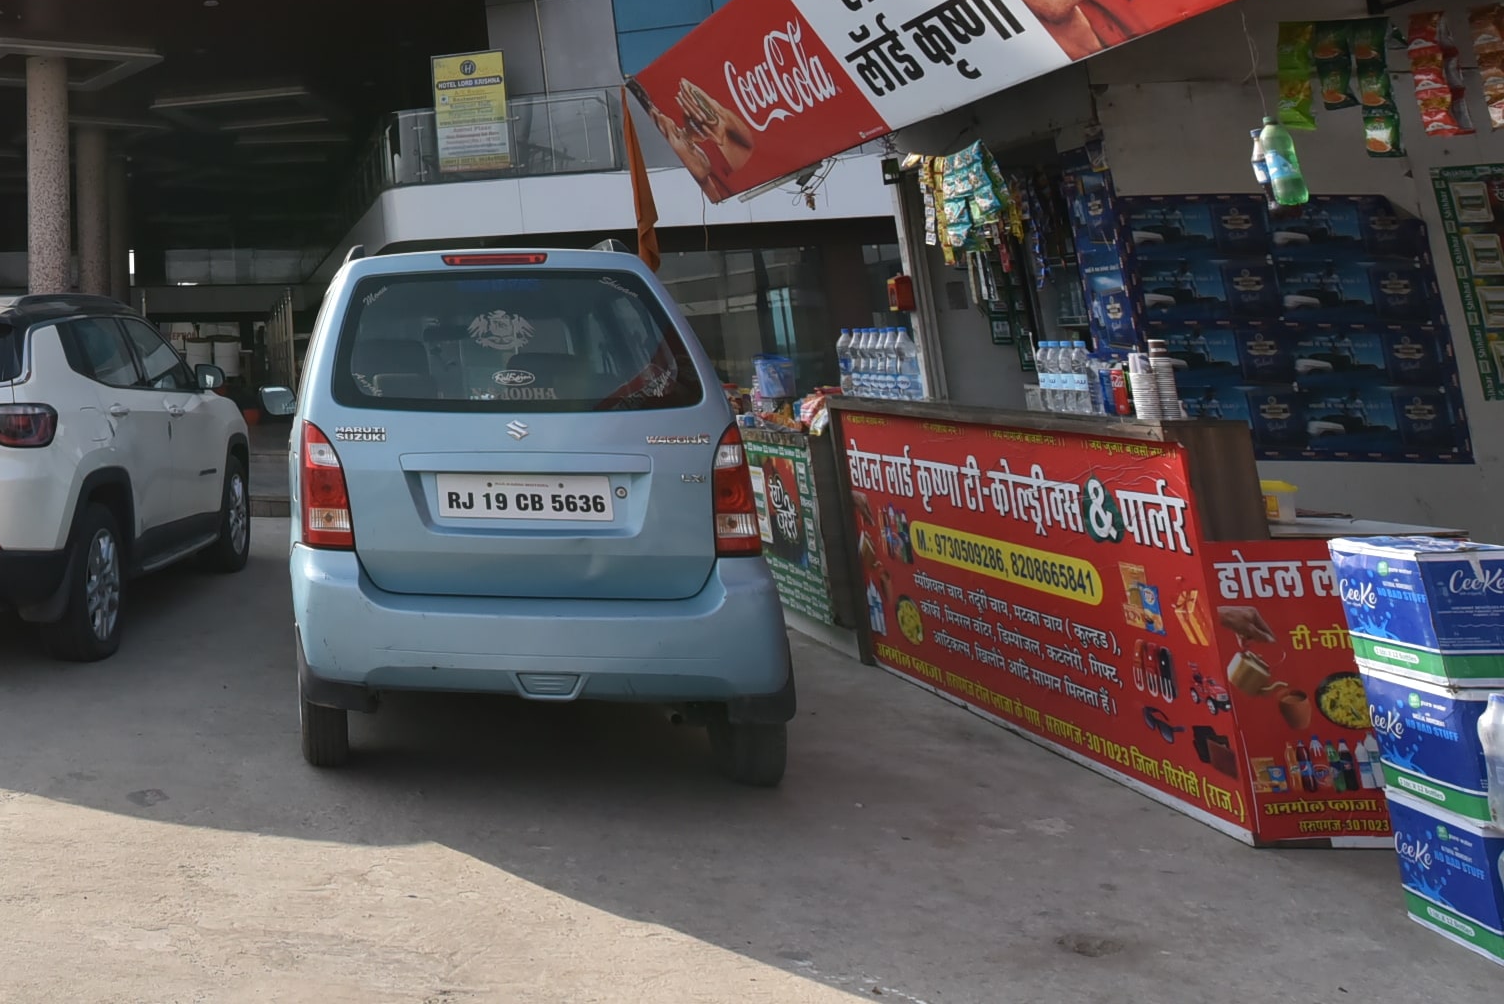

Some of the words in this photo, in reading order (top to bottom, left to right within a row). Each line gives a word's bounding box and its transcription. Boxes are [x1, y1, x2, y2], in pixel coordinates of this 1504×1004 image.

[438, 82, 457, 90] HOTEL
[474, 77, 501, 86] KRISHNA
[724, 17, 837, 133] Coca-Cola
[334, 426, 386, 434] MARUTI
[335, 433, 387, 442] SUZUKI
[447, 492, 474, 512] RJ
[482, 493, 509, 512] 19
[515, 493, 544, 513] CB
[551, 494, 606, 514] 5636
[847, 439, 884, 492] होटल
[914, 459, 962, 512] कृष्णा
[1087, 476, 1118, 539] &
[1116, 478, 1193, 554] पार्लर
[936, 534, 1010, 577] 9730509286,
[1010, 553, 1096, 597] 8208665841
[1213, 549, 1304, 600] होटल
[1339, 579, 1377, 609] CeeKe
[1403, 591, 1427, 604] STUFF
[1041, 613, 1064, 634] चाय
[1289, 624, 1354, 650] टी-को
[1008, 658, 1031, 684] आदि
[1030, 667, 1063, 693] सामान
[1064, 675, 1100, 708] मिलता
[1369, 704, 1404, 739] CeeKe
[1405, 718, 1416, 729] NO
[1417, 721, 1432, 735] BAD
[1433, 727, 1459, 742] STUFF
[1264, 798, 1325, 815] अनमोल
[1394, 831, 1432, 870] CeeKe
[1461, 861, 1485, 880] STUFF
